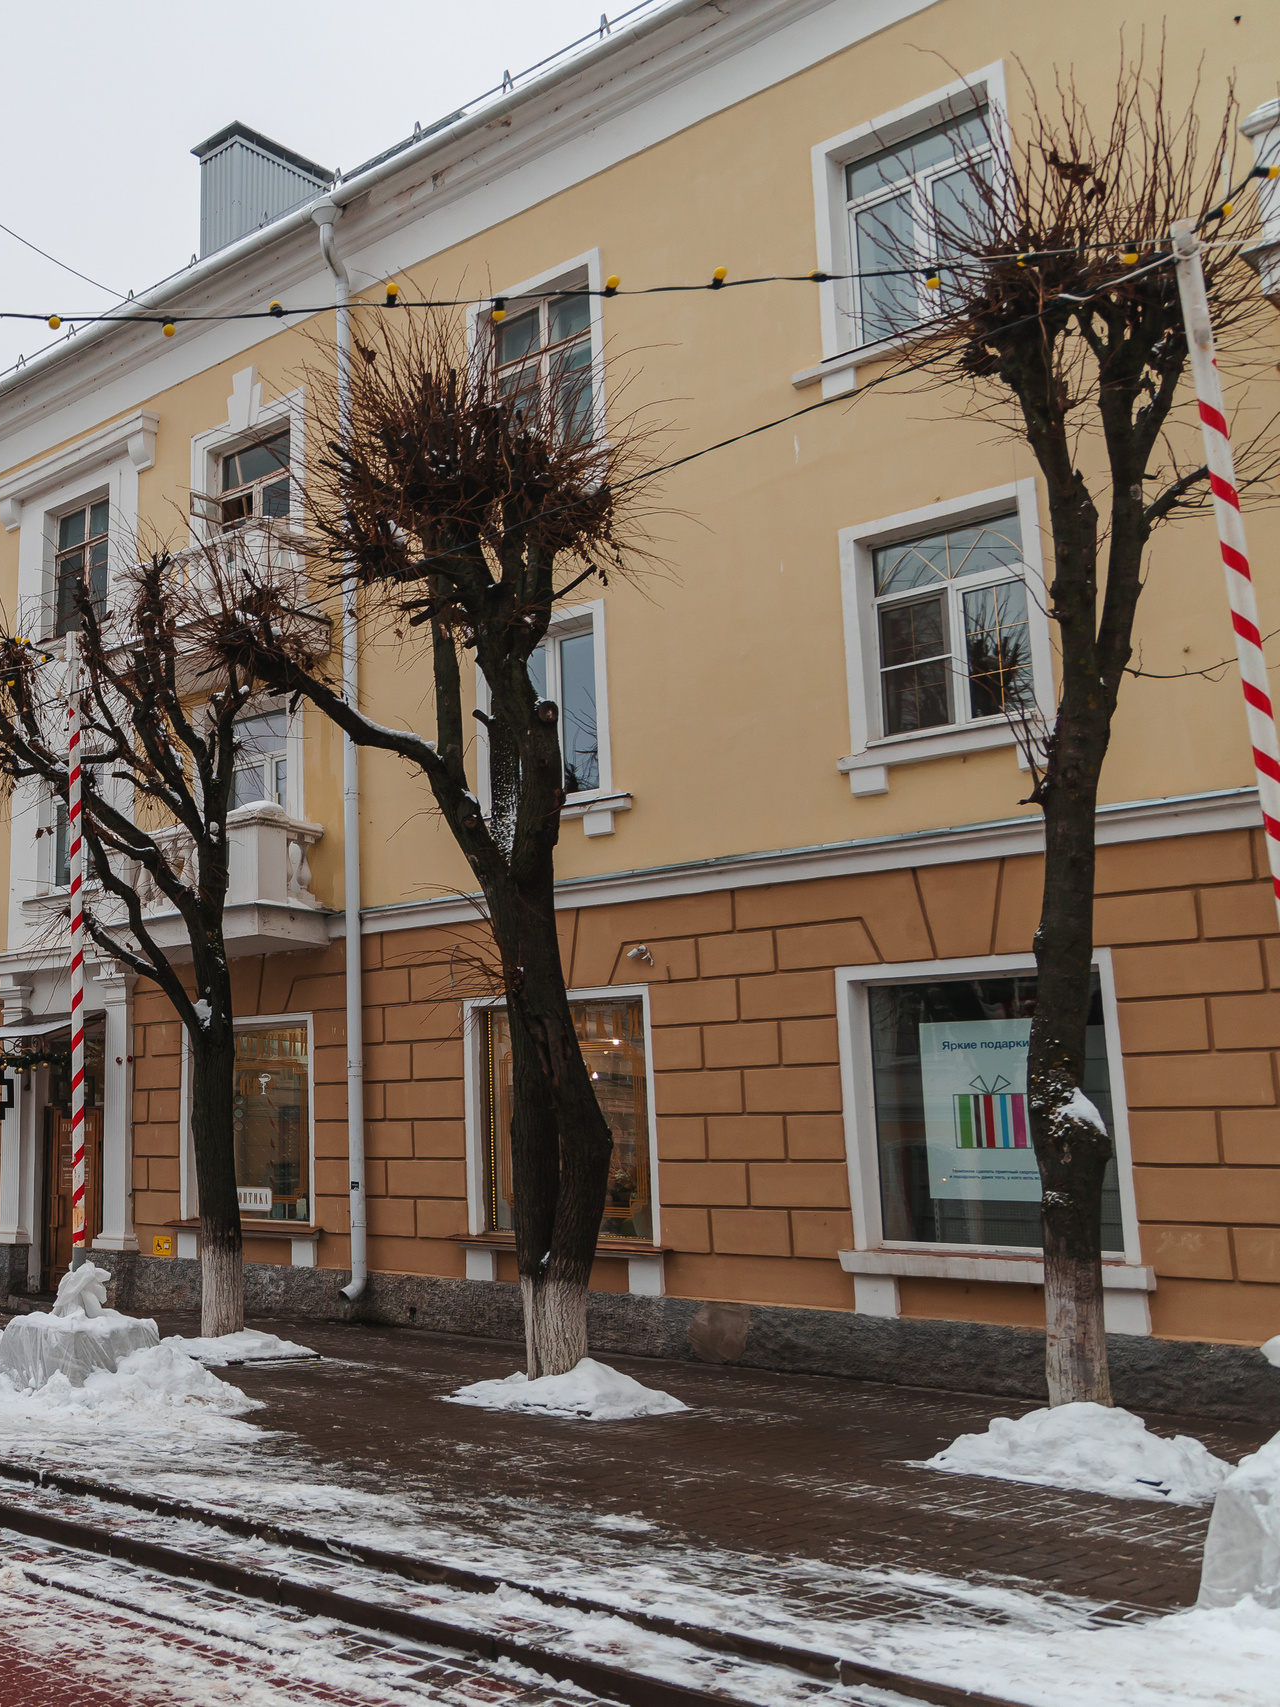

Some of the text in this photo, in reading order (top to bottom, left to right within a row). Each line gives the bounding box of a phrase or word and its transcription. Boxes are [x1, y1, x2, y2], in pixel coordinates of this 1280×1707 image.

[942, 1040, 1030, 1051] Яркие подарки
[238, 1191, 268, 1205] ОПТИКА
